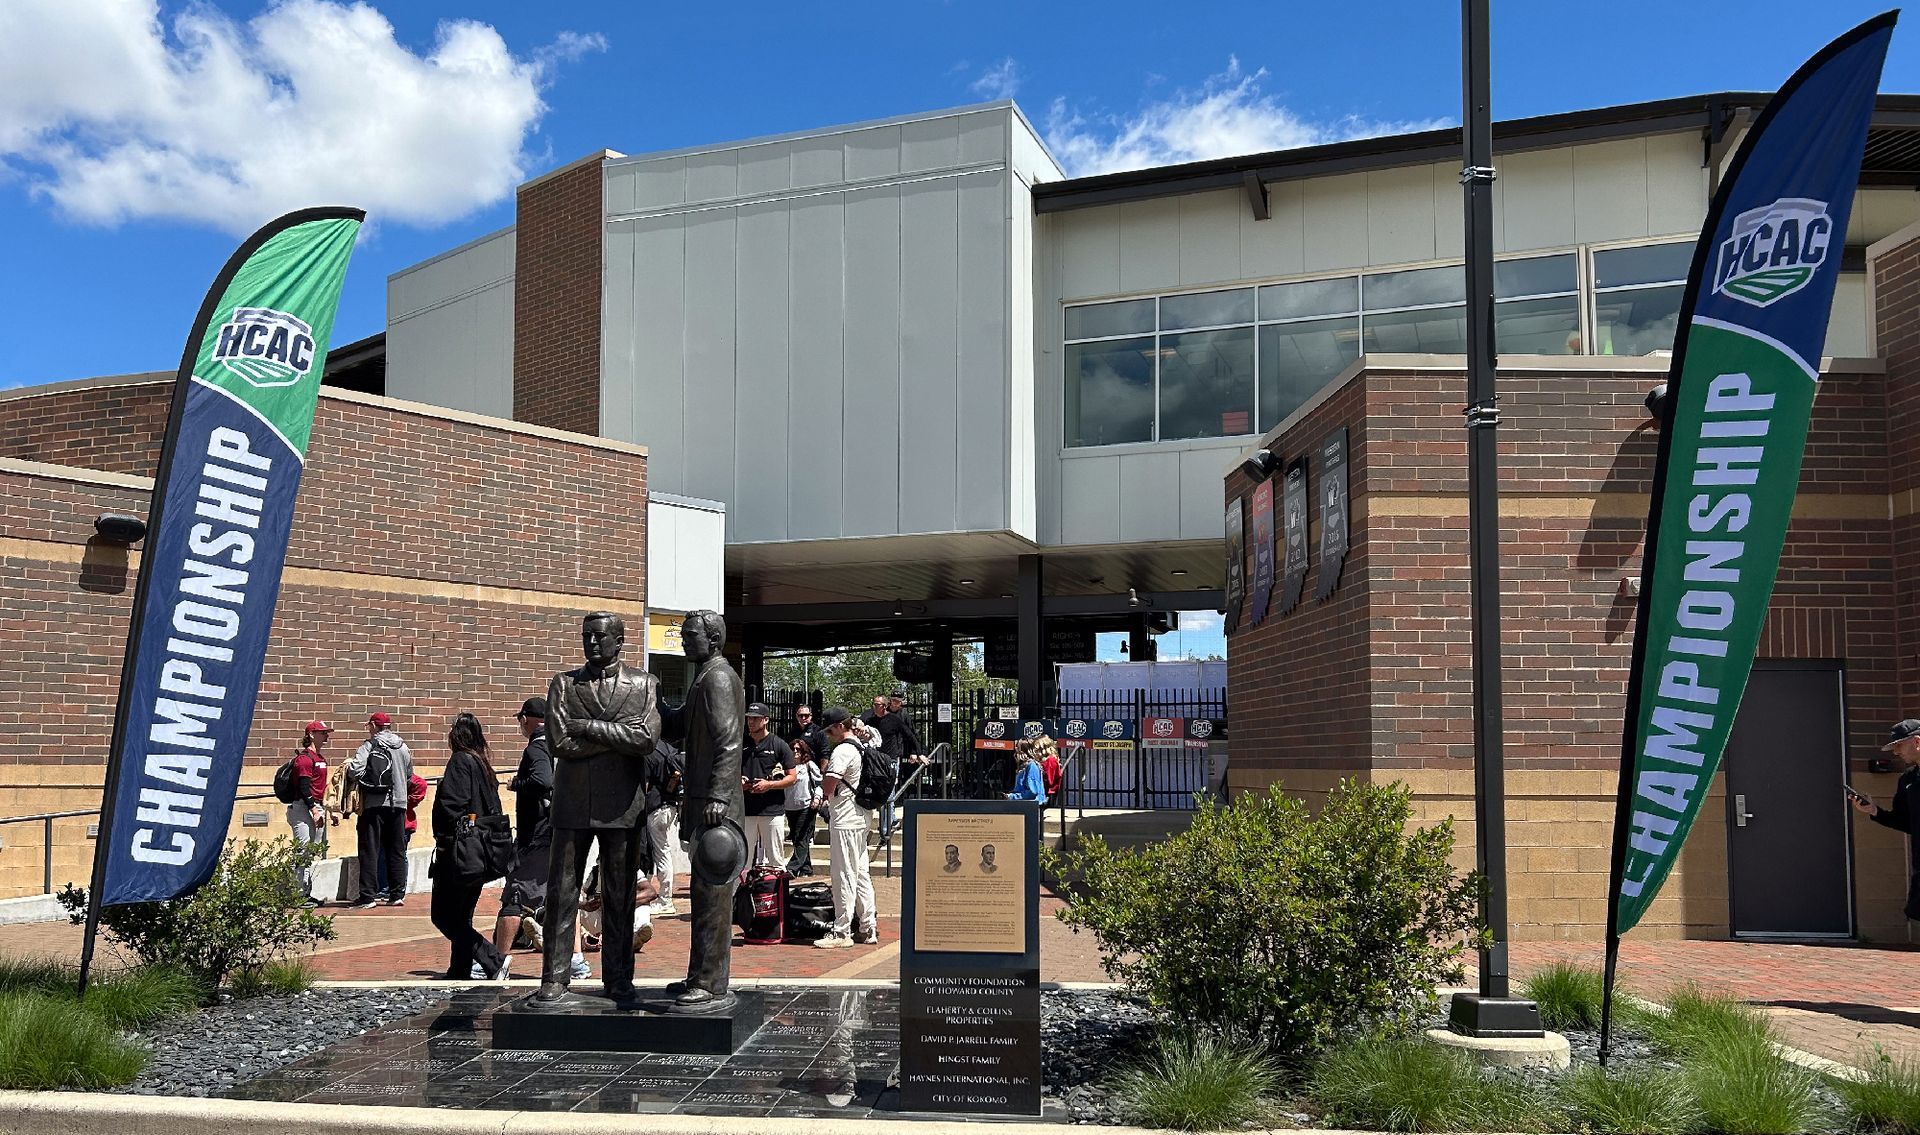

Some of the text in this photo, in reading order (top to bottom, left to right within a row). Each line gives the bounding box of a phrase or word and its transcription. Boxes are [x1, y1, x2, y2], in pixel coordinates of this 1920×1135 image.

[1720, 217, 1830, 280] HCAC
[215, 324, 314, 373] HCAC
[1620, 372, 1777, 898] CHAMPIONSHIP
[130, 425, 273, 867] CHAMPIONSHIP
[986, 724, 1005, 734] HCAC
[1024, 725, 1043, 735] HCAC
[1067, 723, 1087, 733] HCAC
[1104, 724, 1124, 734] HCAC
[1153, 722, 1173, 734] HCAC
[1191, 723, 1212, 734] HCAC
[914, 977, 1025, 986] COMMUNITY FOUNDATION
[939, 987, 976, 995] HOWARD
[979, 988, 1015, 996] COUNTY
[926, 1006, 967, 1014] FLAHERTY
[977, 1007, 1013, 1016] COLLINS
[946, 1017, 994, 1025] PROPERTIES
[920, 1035, 947, 1043] DAVID
[956, 1036, 988, 1045] JARRELL
[990, 1037, 1019, 1045] FAMILY
[938, 1055, 1001, 1064] HINGST FAMILY
[909, 1074, 1031, 1085] HAYNES INTERNATIONAL, INC.
[932, 1094, 1007, 1104] CITY OF KOKOMO
